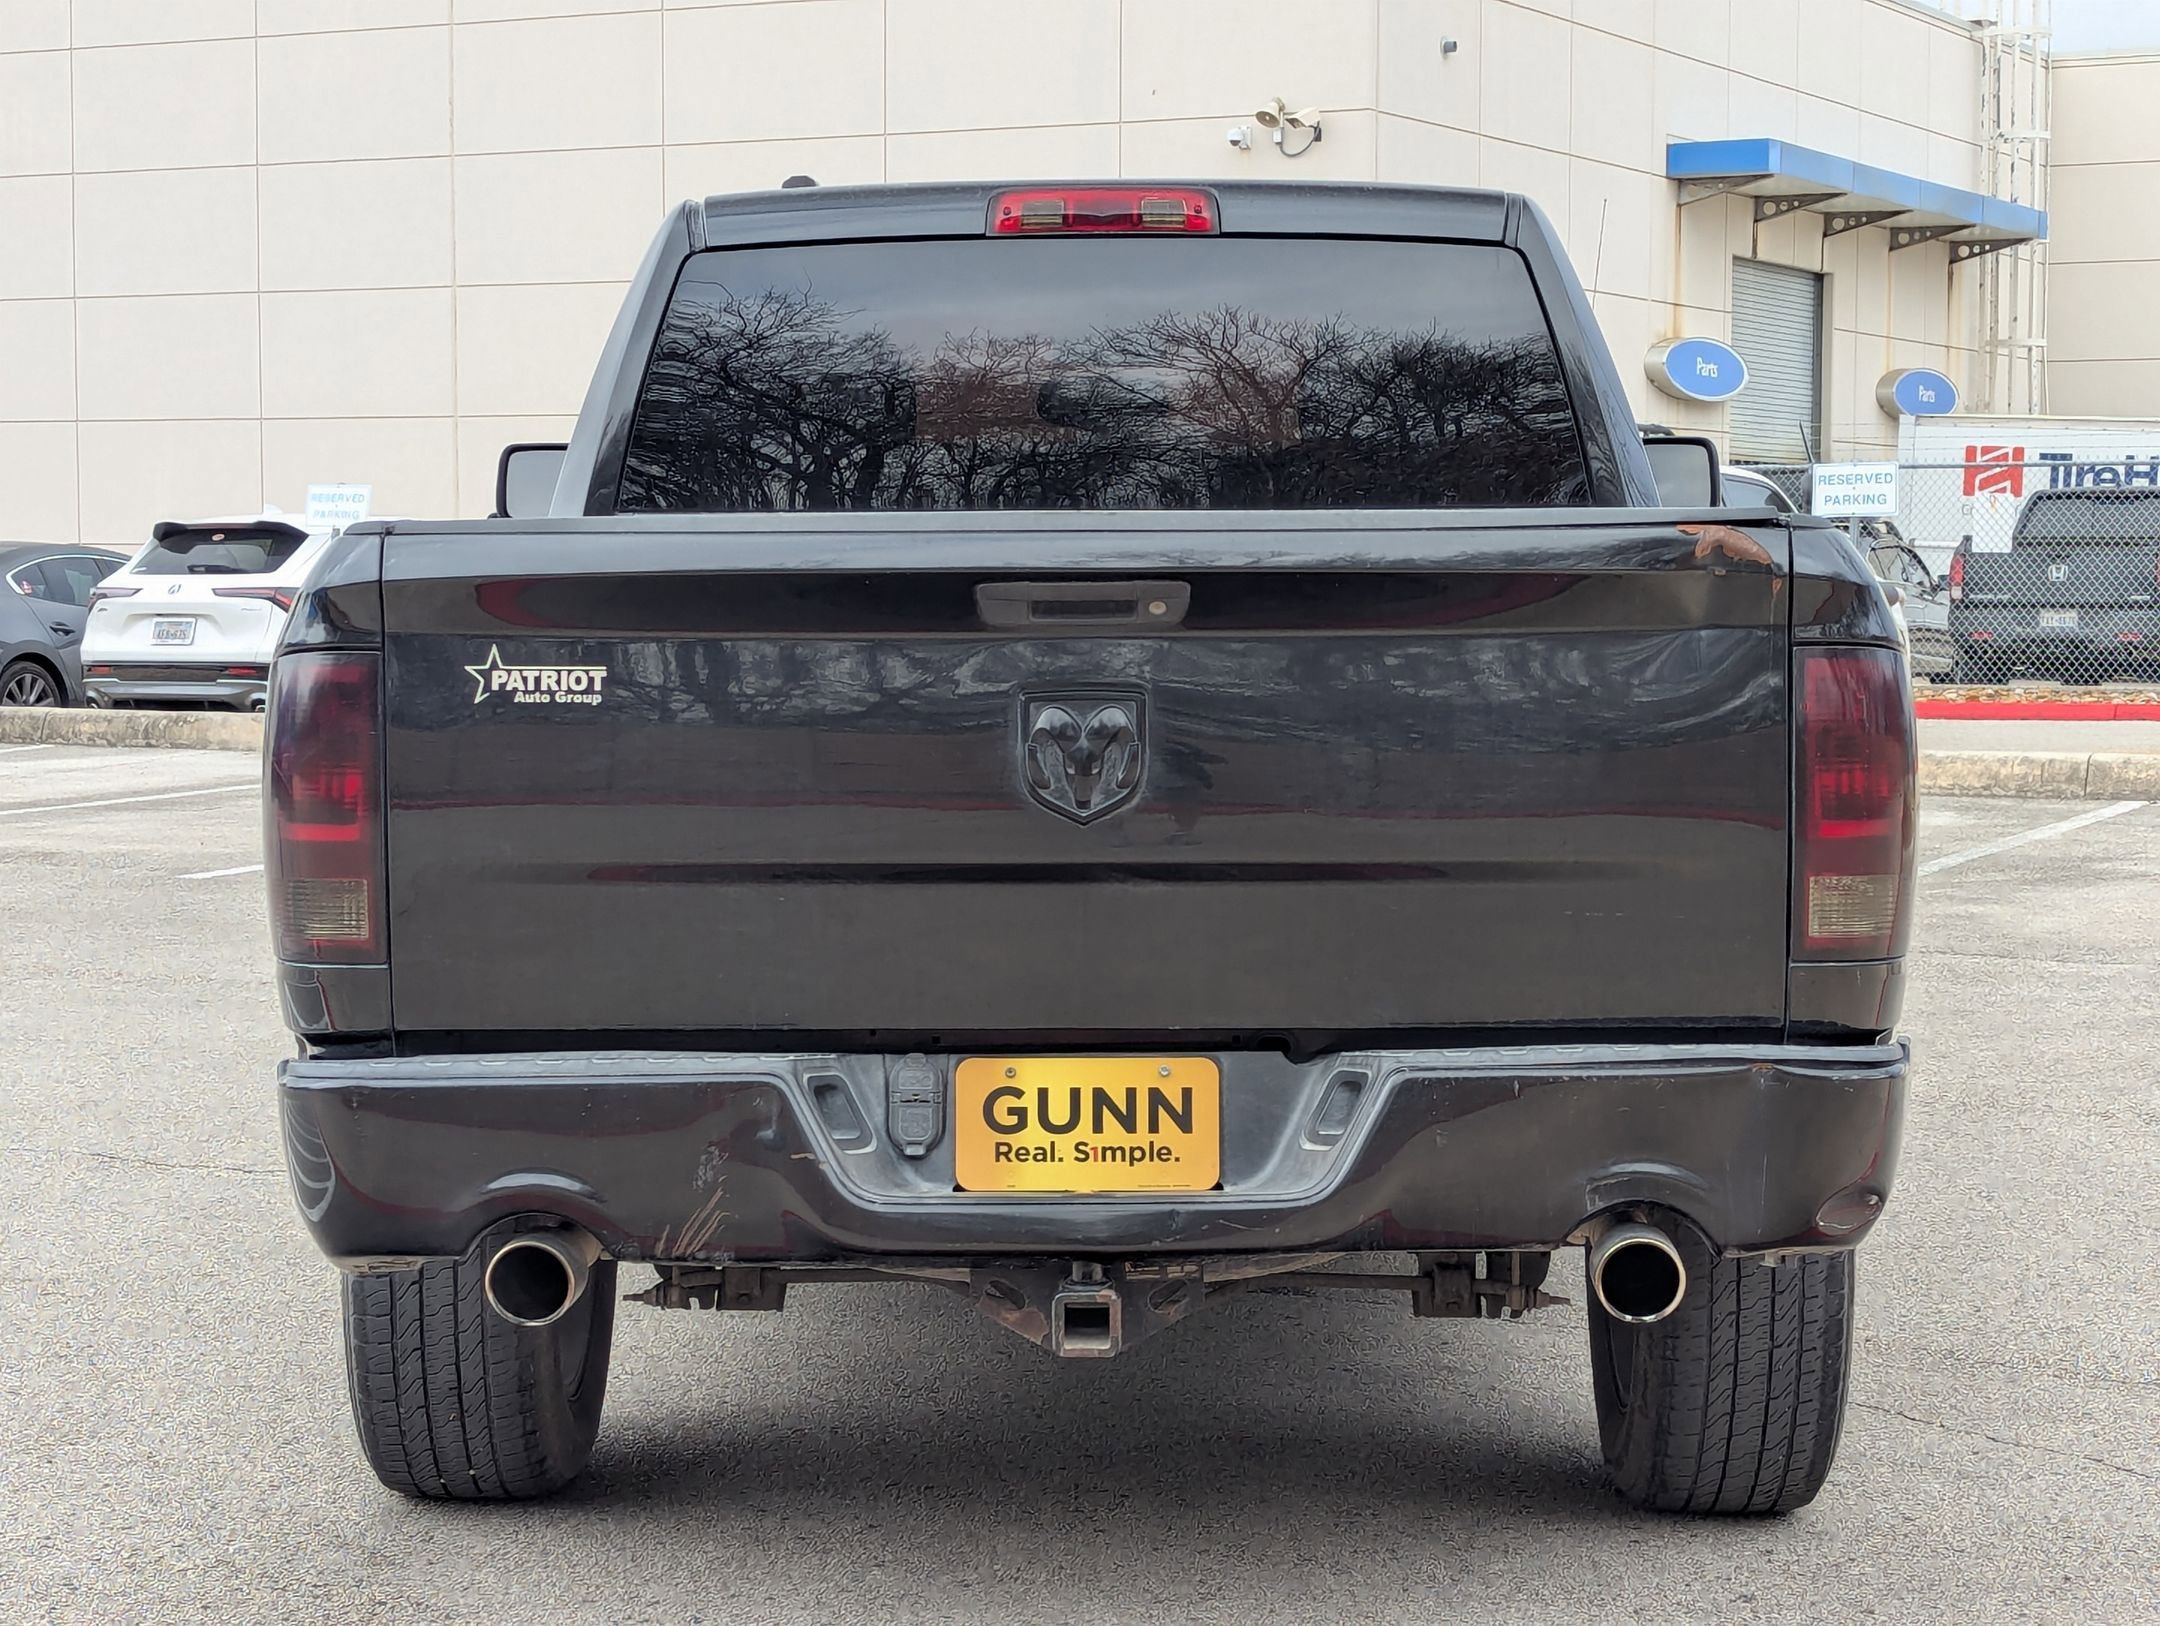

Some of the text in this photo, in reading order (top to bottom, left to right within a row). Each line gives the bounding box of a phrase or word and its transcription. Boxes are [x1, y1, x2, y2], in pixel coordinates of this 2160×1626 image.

[1696, 356, 1718, 378] Parts
[1818, 472, 1893, 485] RESERVED
[311, 492, 365, 503] RESERVED
[1824, 493, 1887, 506] PARKING
[313, 509, 360, 520] PARKING
[491, 670, 607, 691] PATRIOT
[513, 691, 602, 706] Auto Group
[982, 1085, 1193, 1135] GUNN
[994, 1140, 1064, 1163] Real.
